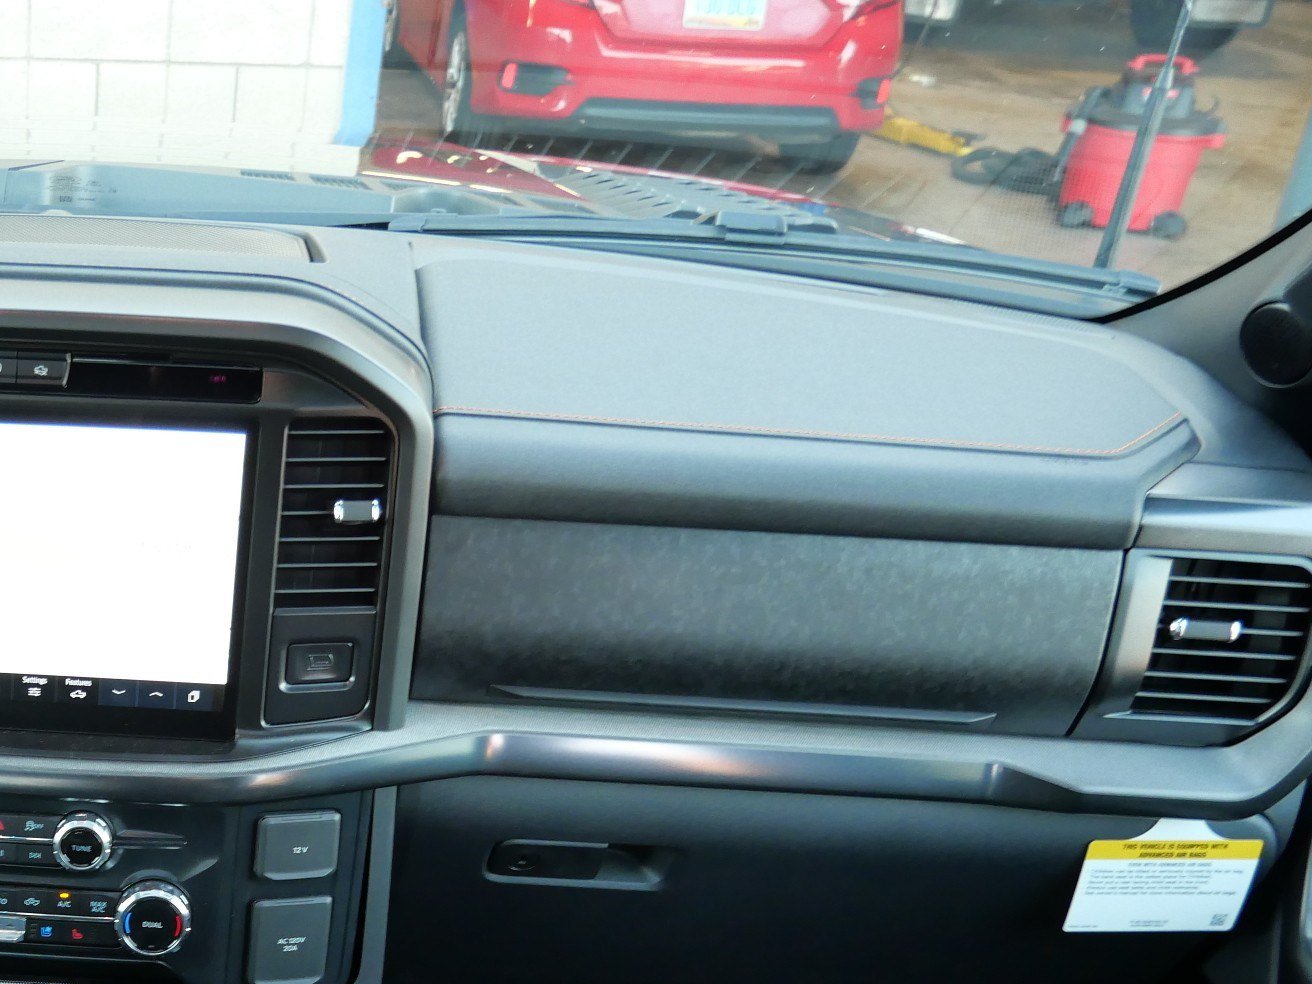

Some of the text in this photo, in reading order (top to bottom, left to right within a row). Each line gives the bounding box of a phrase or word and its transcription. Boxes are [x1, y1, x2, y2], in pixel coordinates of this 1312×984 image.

[22, 676, 48, 686] Settings
[65, 678, 92, 687] Features
[71, 844, 92, 853] TUNE
[292, 846, 309, 854] 12V
[142, 921, 163, 929] DUAL
